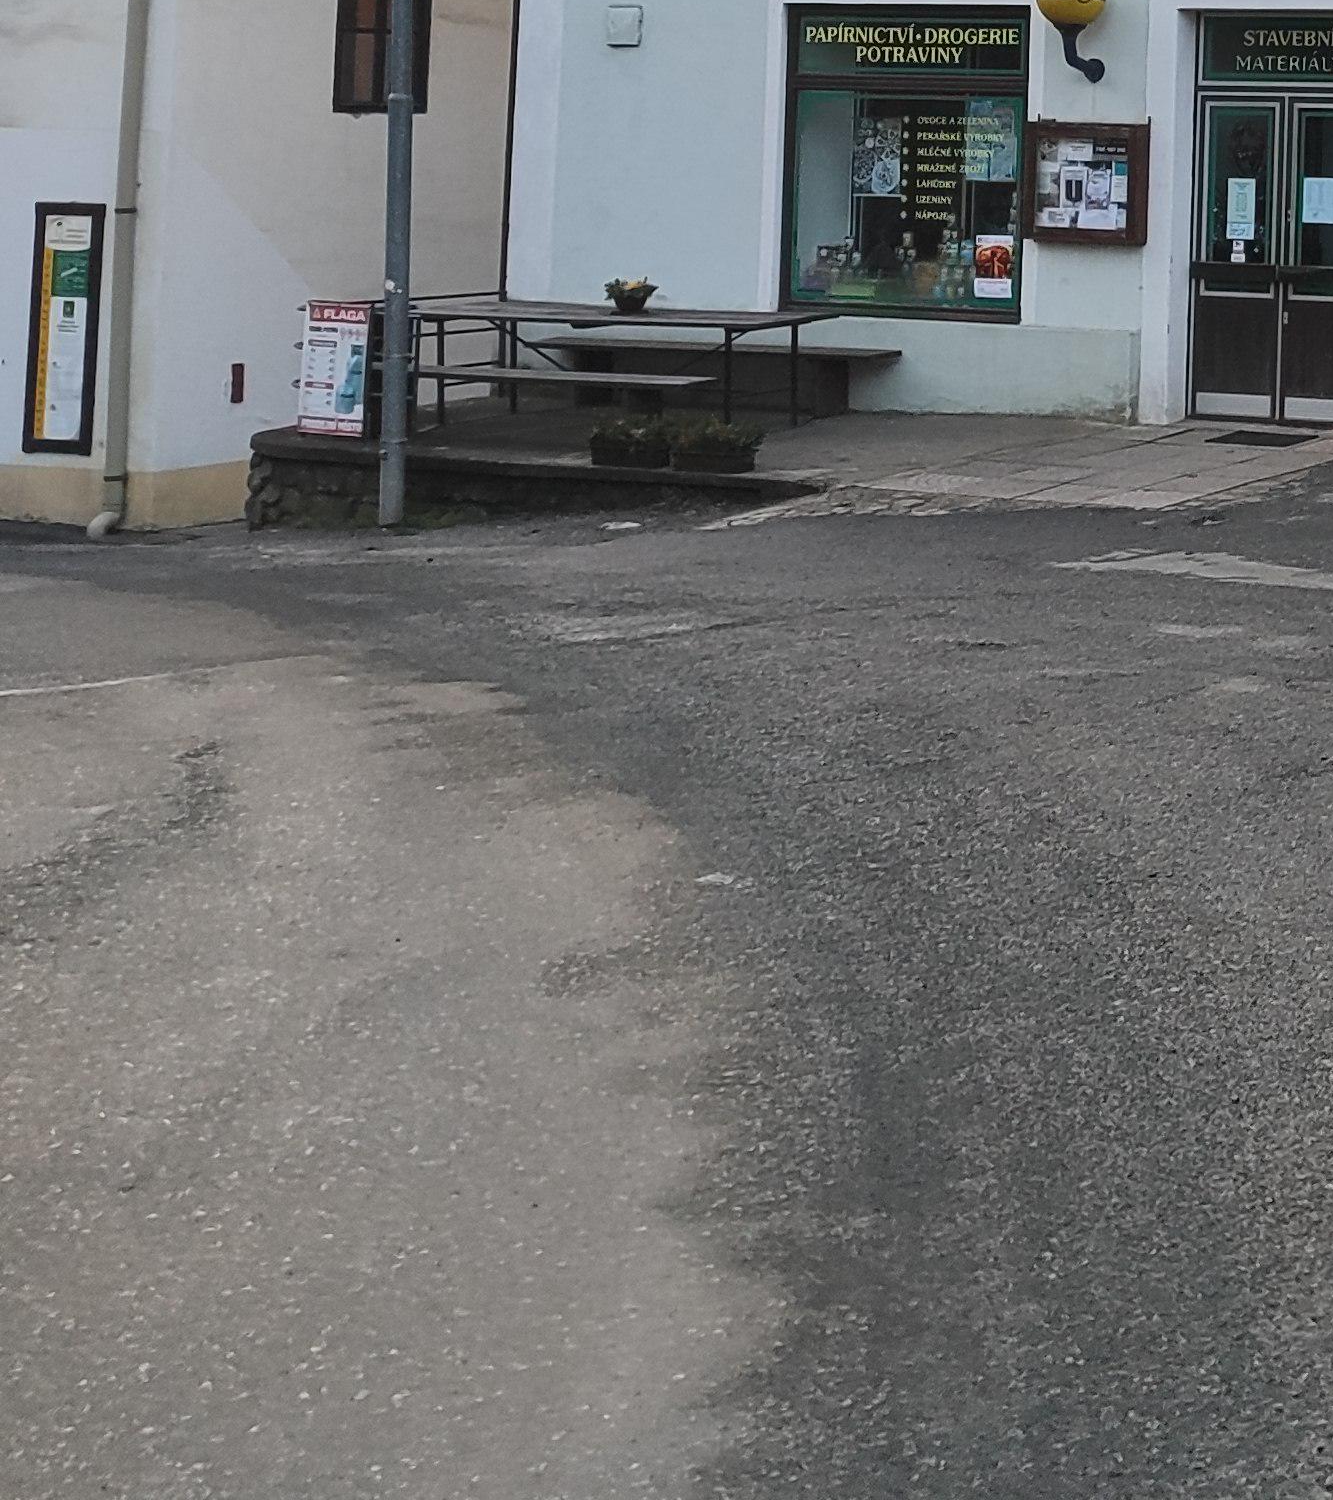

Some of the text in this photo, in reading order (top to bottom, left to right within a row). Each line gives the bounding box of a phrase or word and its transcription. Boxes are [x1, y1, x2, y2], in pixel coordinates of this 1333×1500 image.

[805, 23, 1020, 45] PAPÍRNICTVÍ DROGERIE
[855, 46, 964, 64] POTRAVINY
[915, 195, 953, 205] UZENINY
